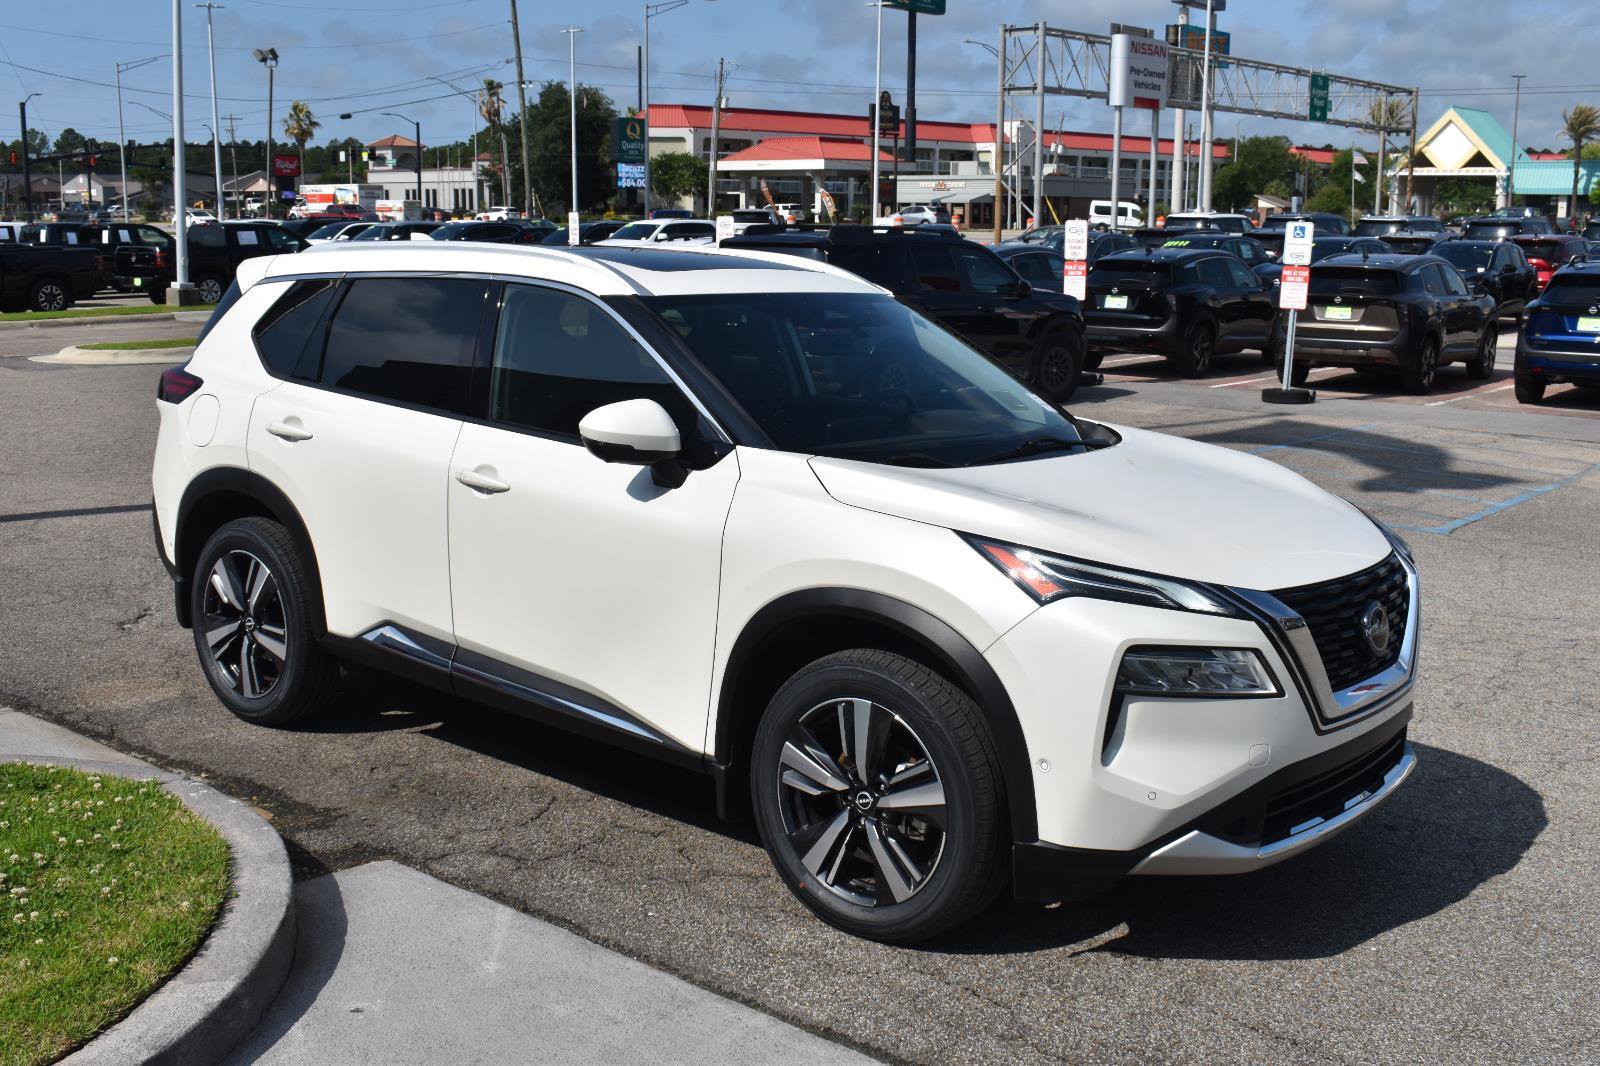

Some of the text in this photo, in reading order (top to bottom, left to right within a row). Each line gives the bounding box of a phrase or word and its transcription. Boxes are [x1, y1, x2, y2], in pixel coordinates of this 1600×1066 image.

[1130, 41, 1167, 58] NISSAN
[1129, 66, 1166, 79] Pre-Owned
[1133, 80, 1161, 91] Vehicles
[626, 121, 641, 140] Q
[621, 140, 645, 151] Quality
